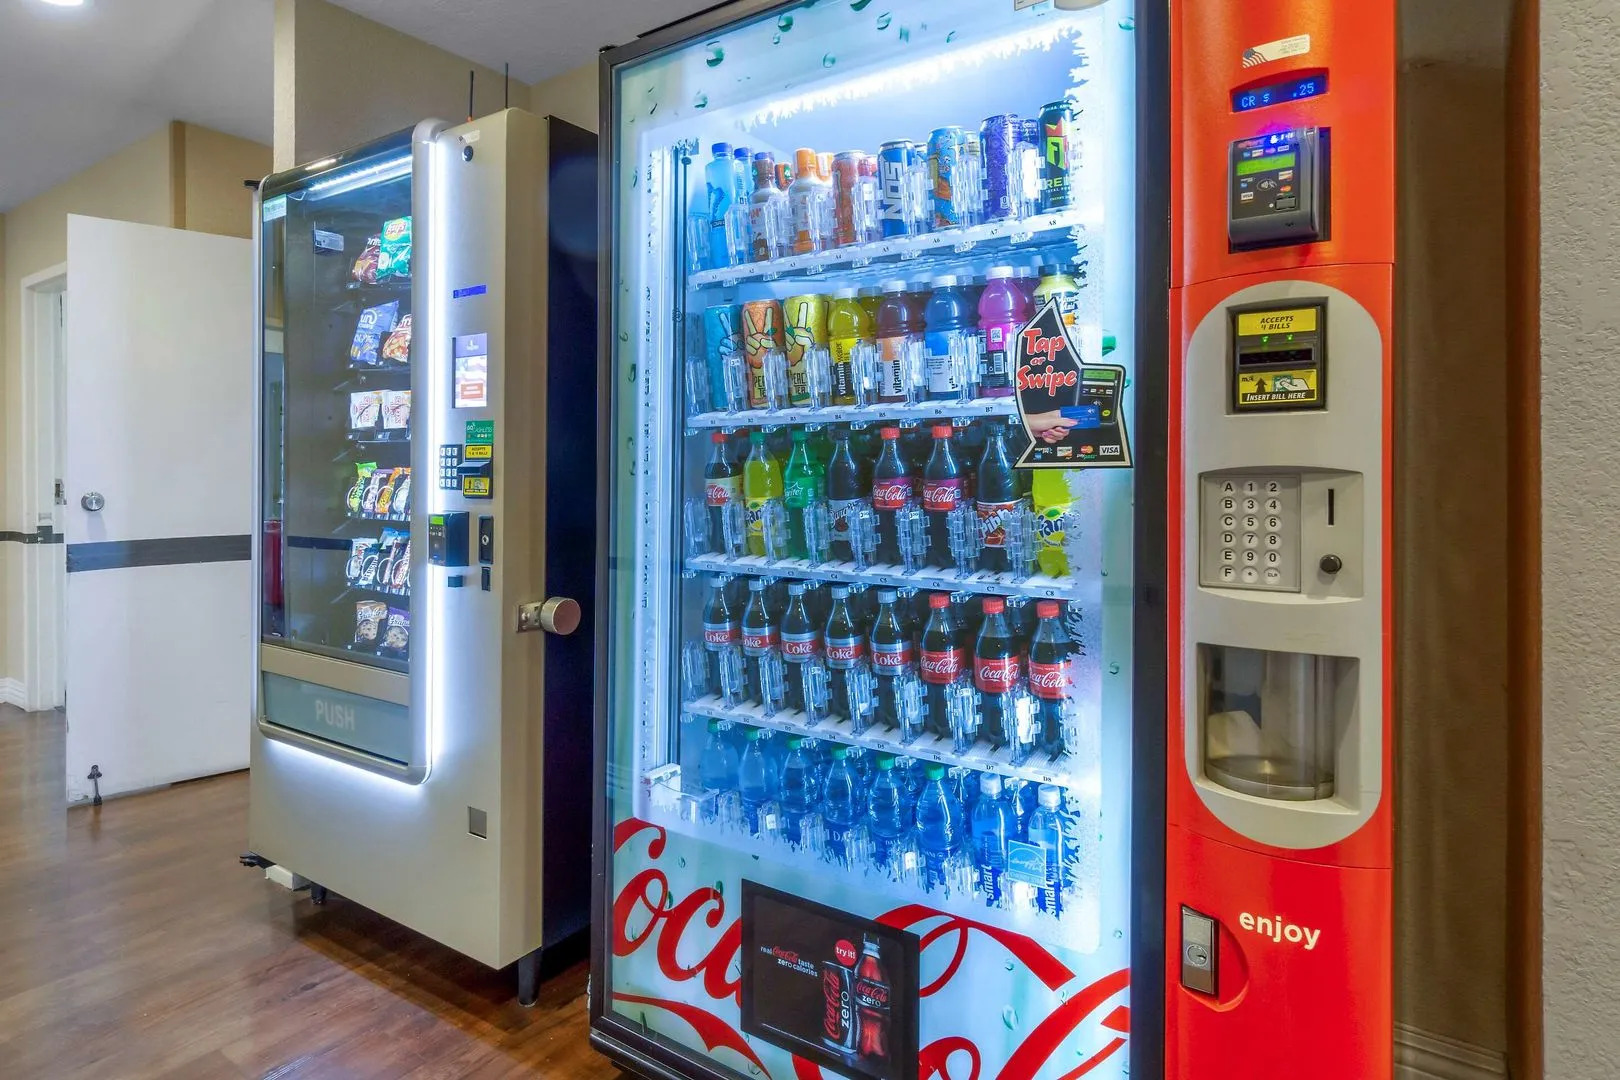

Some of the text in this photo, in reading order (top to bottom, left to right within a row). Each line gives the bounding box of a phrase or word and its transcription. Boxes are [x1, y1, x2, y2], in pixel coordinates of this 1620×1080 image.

[1241, 82, 1315, 108] CR $ .25
[884, 162, 903, 220] NOS
[1260, 315, 1294, 324] ACCEPTS
[1268, 322, 1291, 330] BILLS
[1024, 328, 1066, 361] Tap
[1030, 357, 1046, 365] or
[892, 359, 902, 395] vitamin
[1017, 365, 1078, 397] Swipe
[1246, 391, 1306, 402] INSERT BILL HERE
[1101, 446, 1119, 454] VISA
[1225, 483, 1233, 491] A
[1248, 484, 1253, 492] 1
[1270, 484, 1276, 492] 2
[1248, 500, 1254, 509] 3
[1270, 501, 1277, 509] 4
[1225, 517, 1232, 525] C
[1248, 518, 1254, 526] 5
[1270, 518, 1276, 527] 6
[1270, 536, 1276, 544] 8
[1225, 551, 1232, 560] E
[1247, 552, 1253, 560] 9
[1270, 554, 1276, 562] 0
[1225, 569, 1232, 577] F
[704, 630, 729, 643] Coke
[743, 637, 762, 648] oke
[785, 641, 813, 655] Coke
[826, 647, 853, 660] Coke
[873, 653, 901, 666] Coke
[315, 700, 355, 731] PUSH
[981, 864, 994, 900] smart
[1239, 911, 1321, 951] enjoy
[760, 945, 815, 970] real Coca-Cola taste
[836, 947, 856, 960] try it!
[778, 958, 818, 978] zero calories
[856, 981, 889, 1003] Coca-Cola
[862, 994, 882, 1007] zero
[841, 991, 850, 1028] zero
